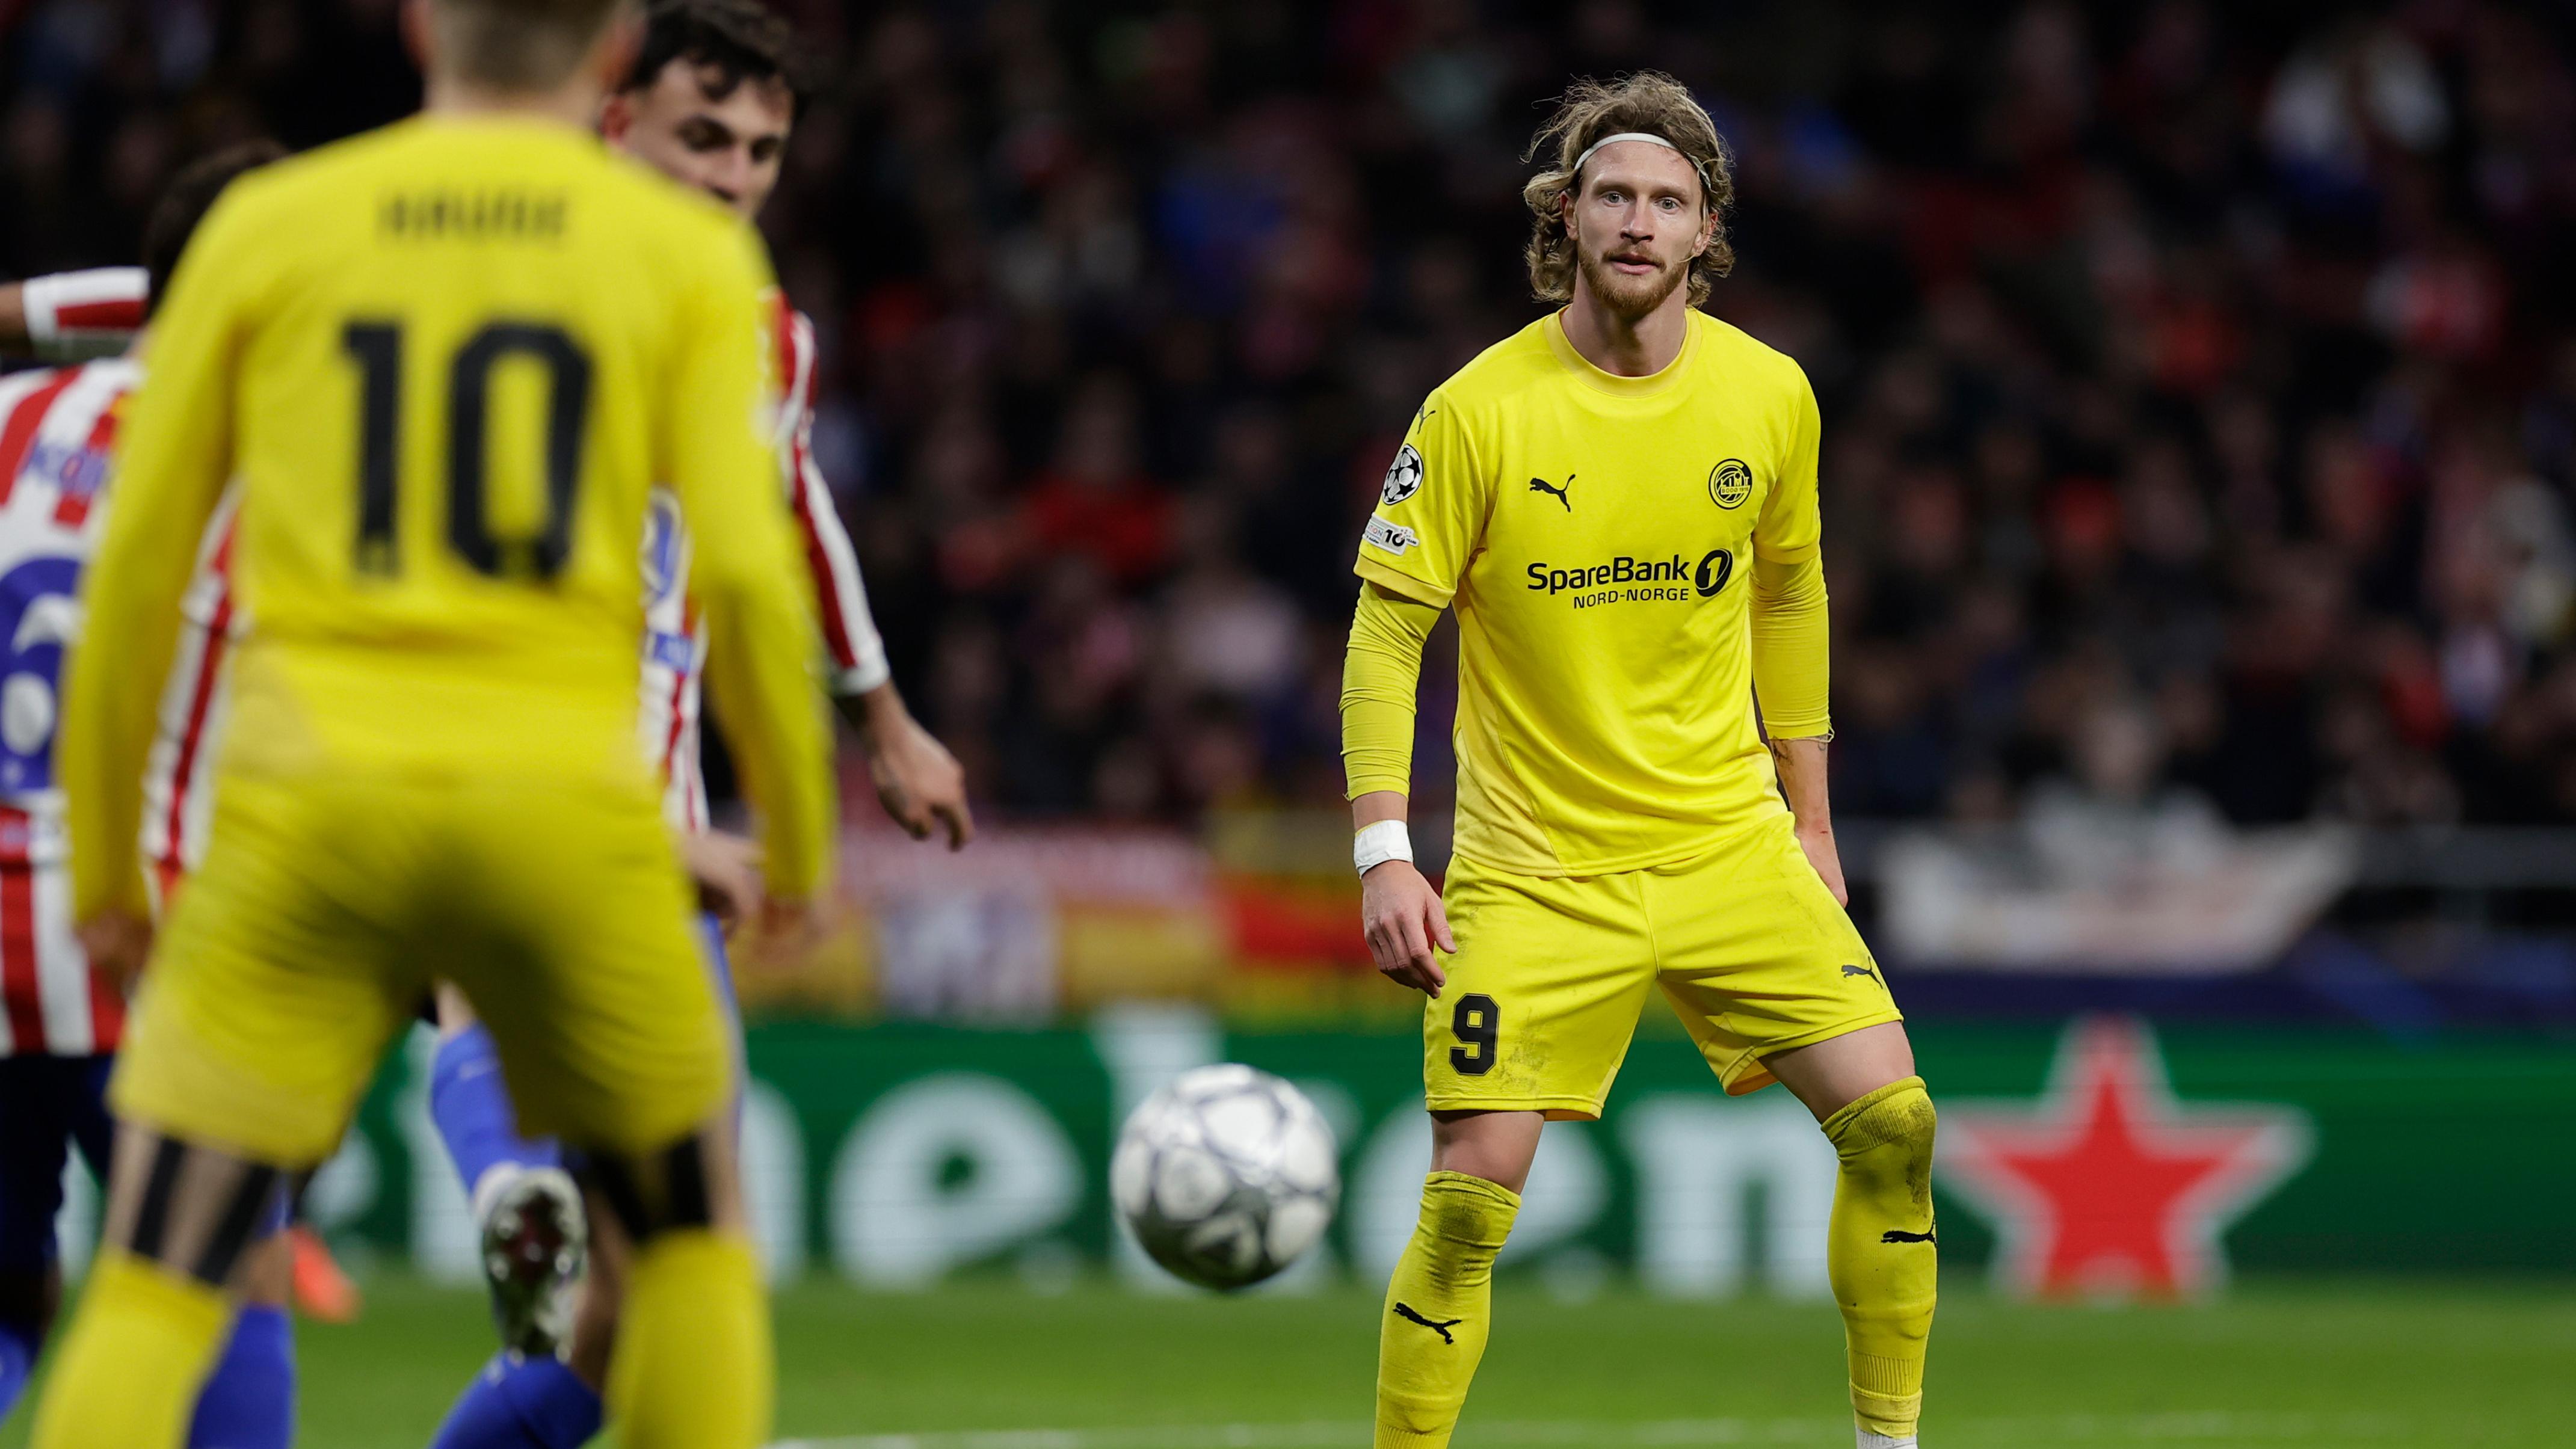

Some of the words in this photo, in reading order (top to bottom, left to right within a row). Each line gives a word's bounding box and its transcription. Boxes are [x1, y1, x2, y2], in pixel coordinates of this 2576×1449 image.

[340, 316, 596, 579] 10
[1527, 554, 1690, 595] SpareBank
[1574, 588, 1689, 609] NORD-NORGE
[1449, 993, 1500, 1076] 9
